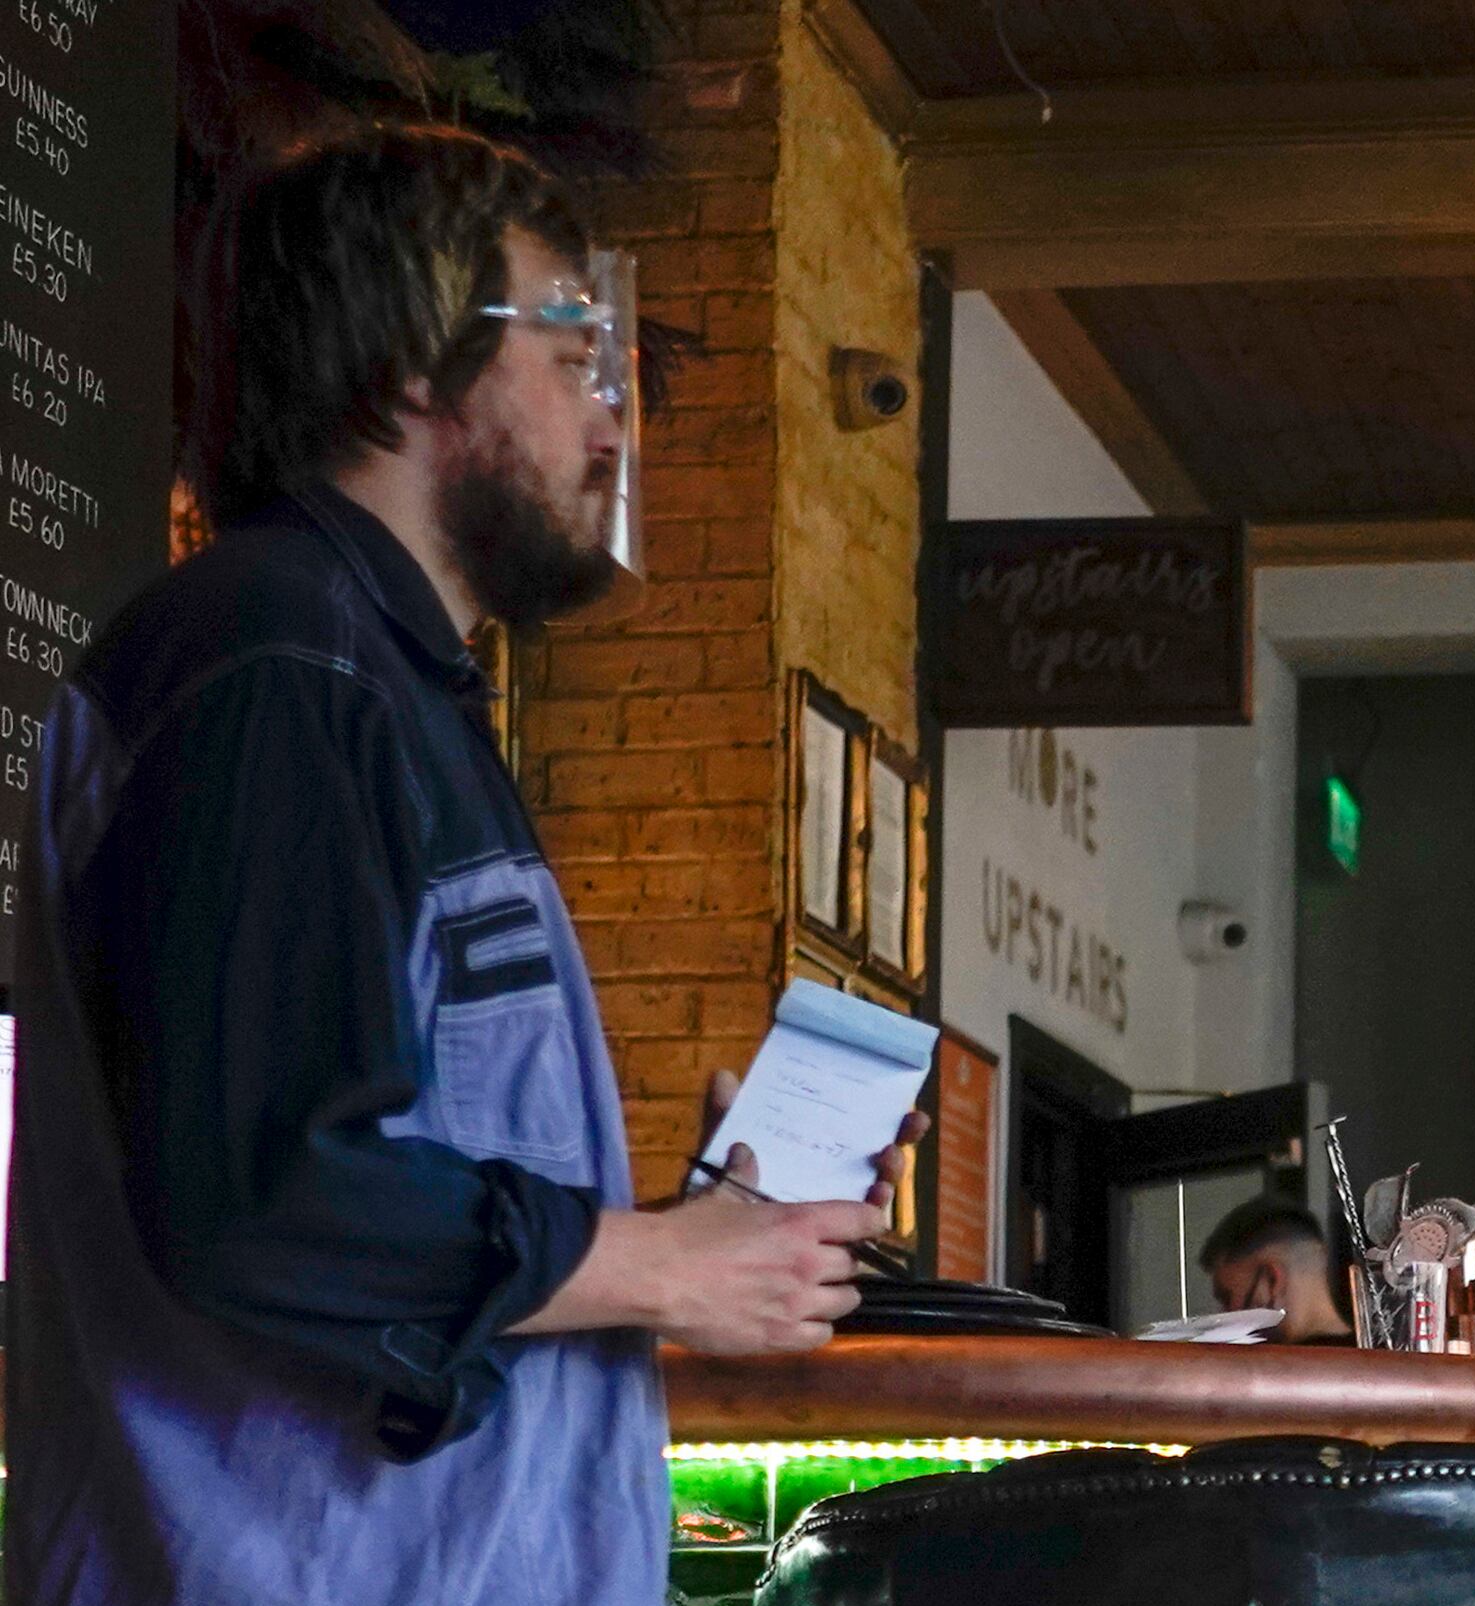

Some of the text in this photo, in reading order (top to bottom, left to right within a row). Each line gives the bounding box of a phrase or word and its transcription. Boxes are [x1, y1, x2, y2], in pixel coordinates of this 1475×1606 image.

[19, 0, 73, 53] £6.50
[16, 117, 71, 176] £5.40
[12, 242, 68, 303] £5.30
[12, 372, 68, 427] £6.20
[77, 365, 106, 408] IPA
[11, 452, 99, 529] MORETTI
[9, 497, 65, 551] £5.60
[0, 573, 93, 648] OWN NECK
[7, 627, 63, 678] £6.30
[1007, 627, 1167, 694] open
